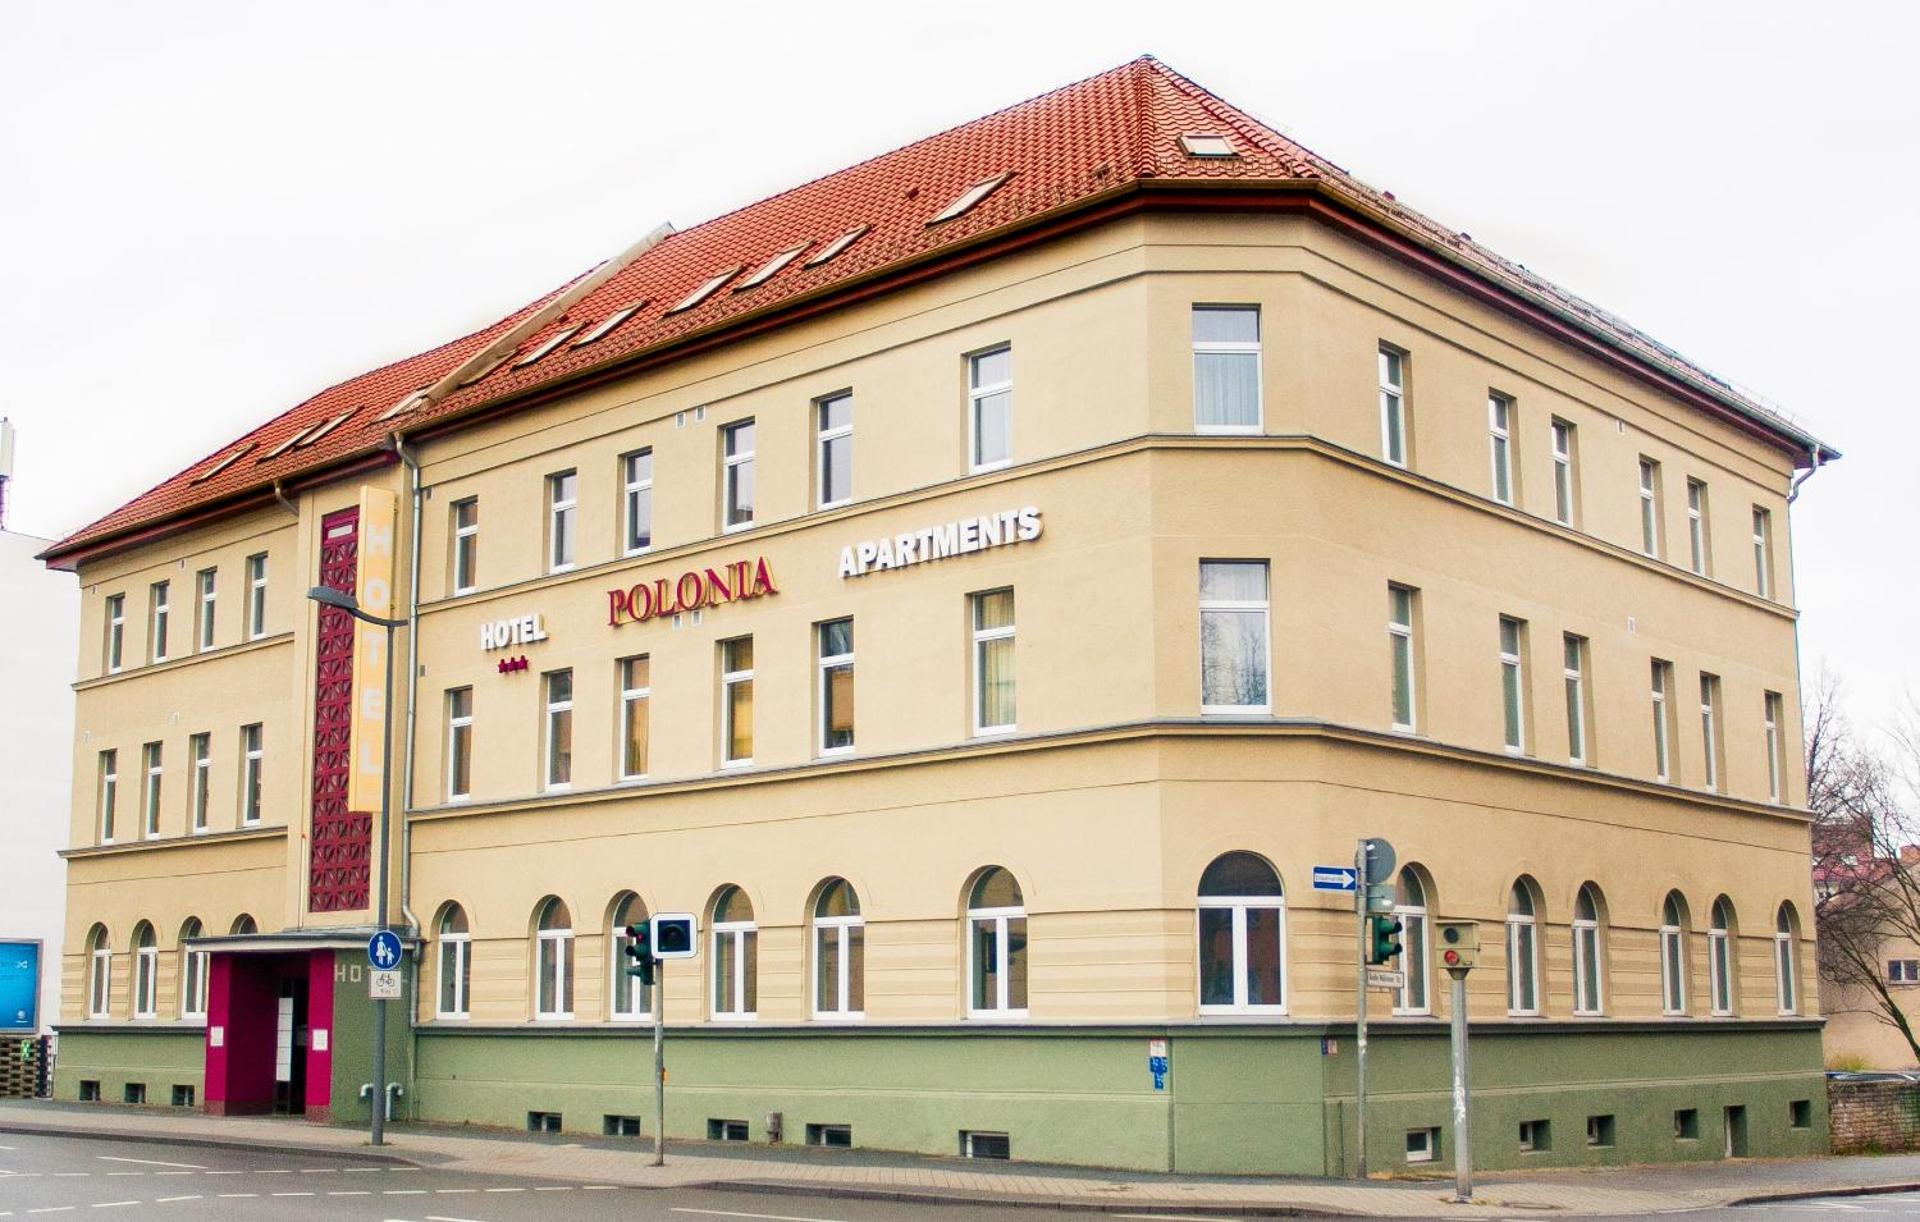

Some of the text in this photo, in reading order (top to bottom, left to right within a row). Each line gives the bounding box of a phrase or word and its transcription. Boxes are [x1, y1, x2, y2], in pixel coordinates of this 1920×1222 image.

[359, 525, 390, 774] HOTEL
[480, 505, 1043, 652] HOTEL POLONIA APARTMENTS
